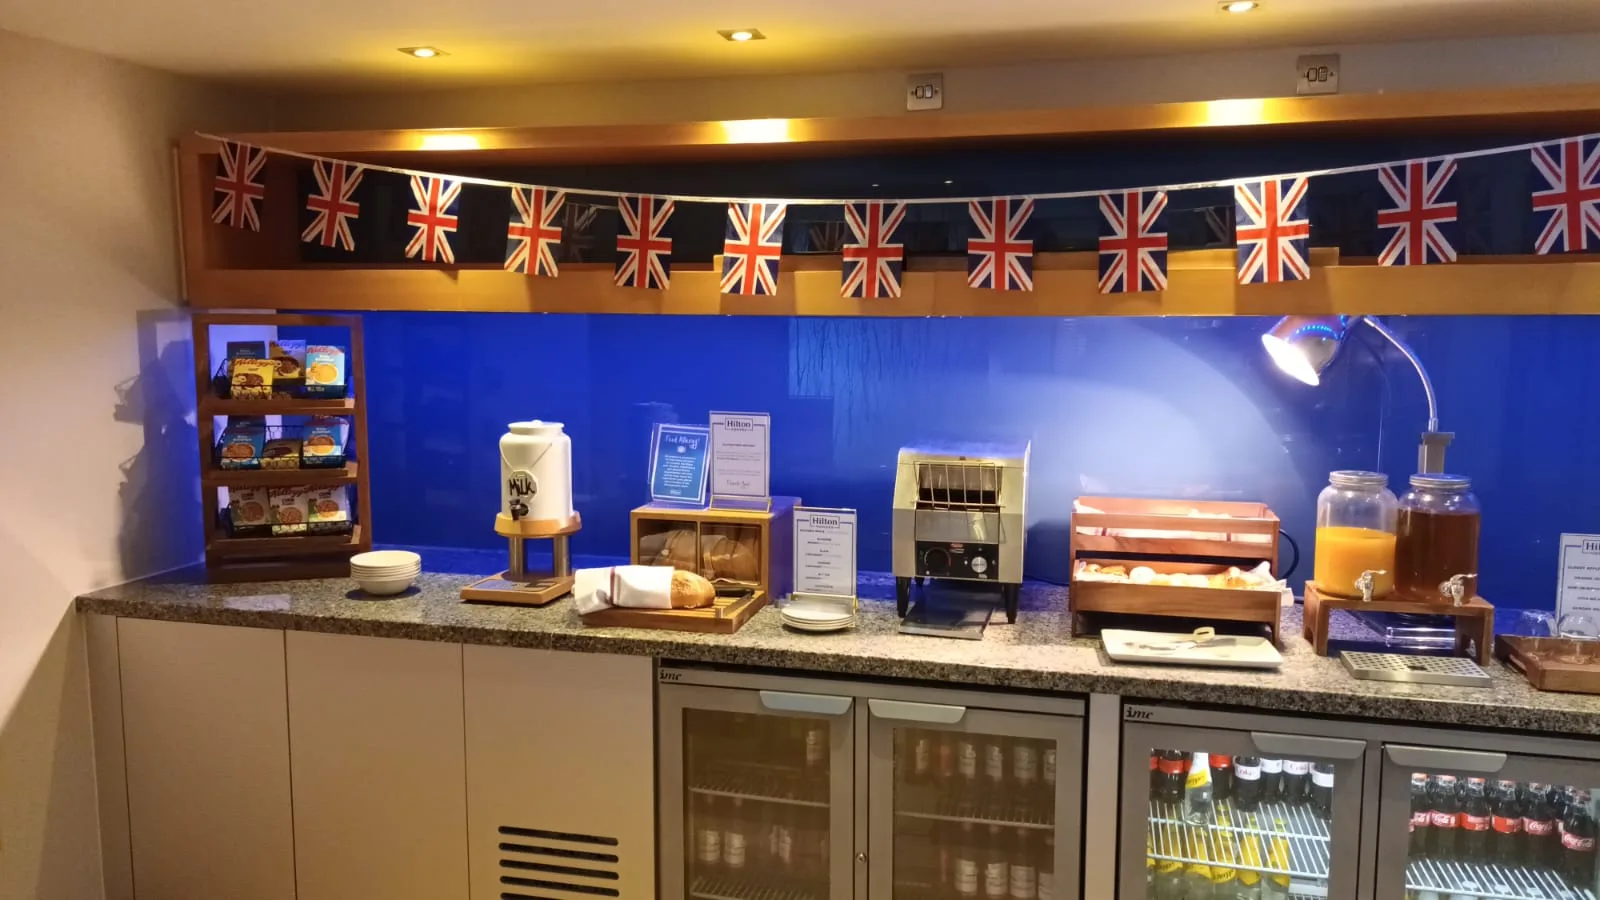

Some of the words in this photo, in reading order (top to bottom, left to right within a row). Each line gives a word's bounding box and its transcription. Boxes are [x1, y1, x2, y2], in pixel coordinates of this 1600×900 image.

[727, 420, 751, 428] Hilton
[812, 516, 838, 526] Hilton
[1126, 706, 1154, 719] imc
